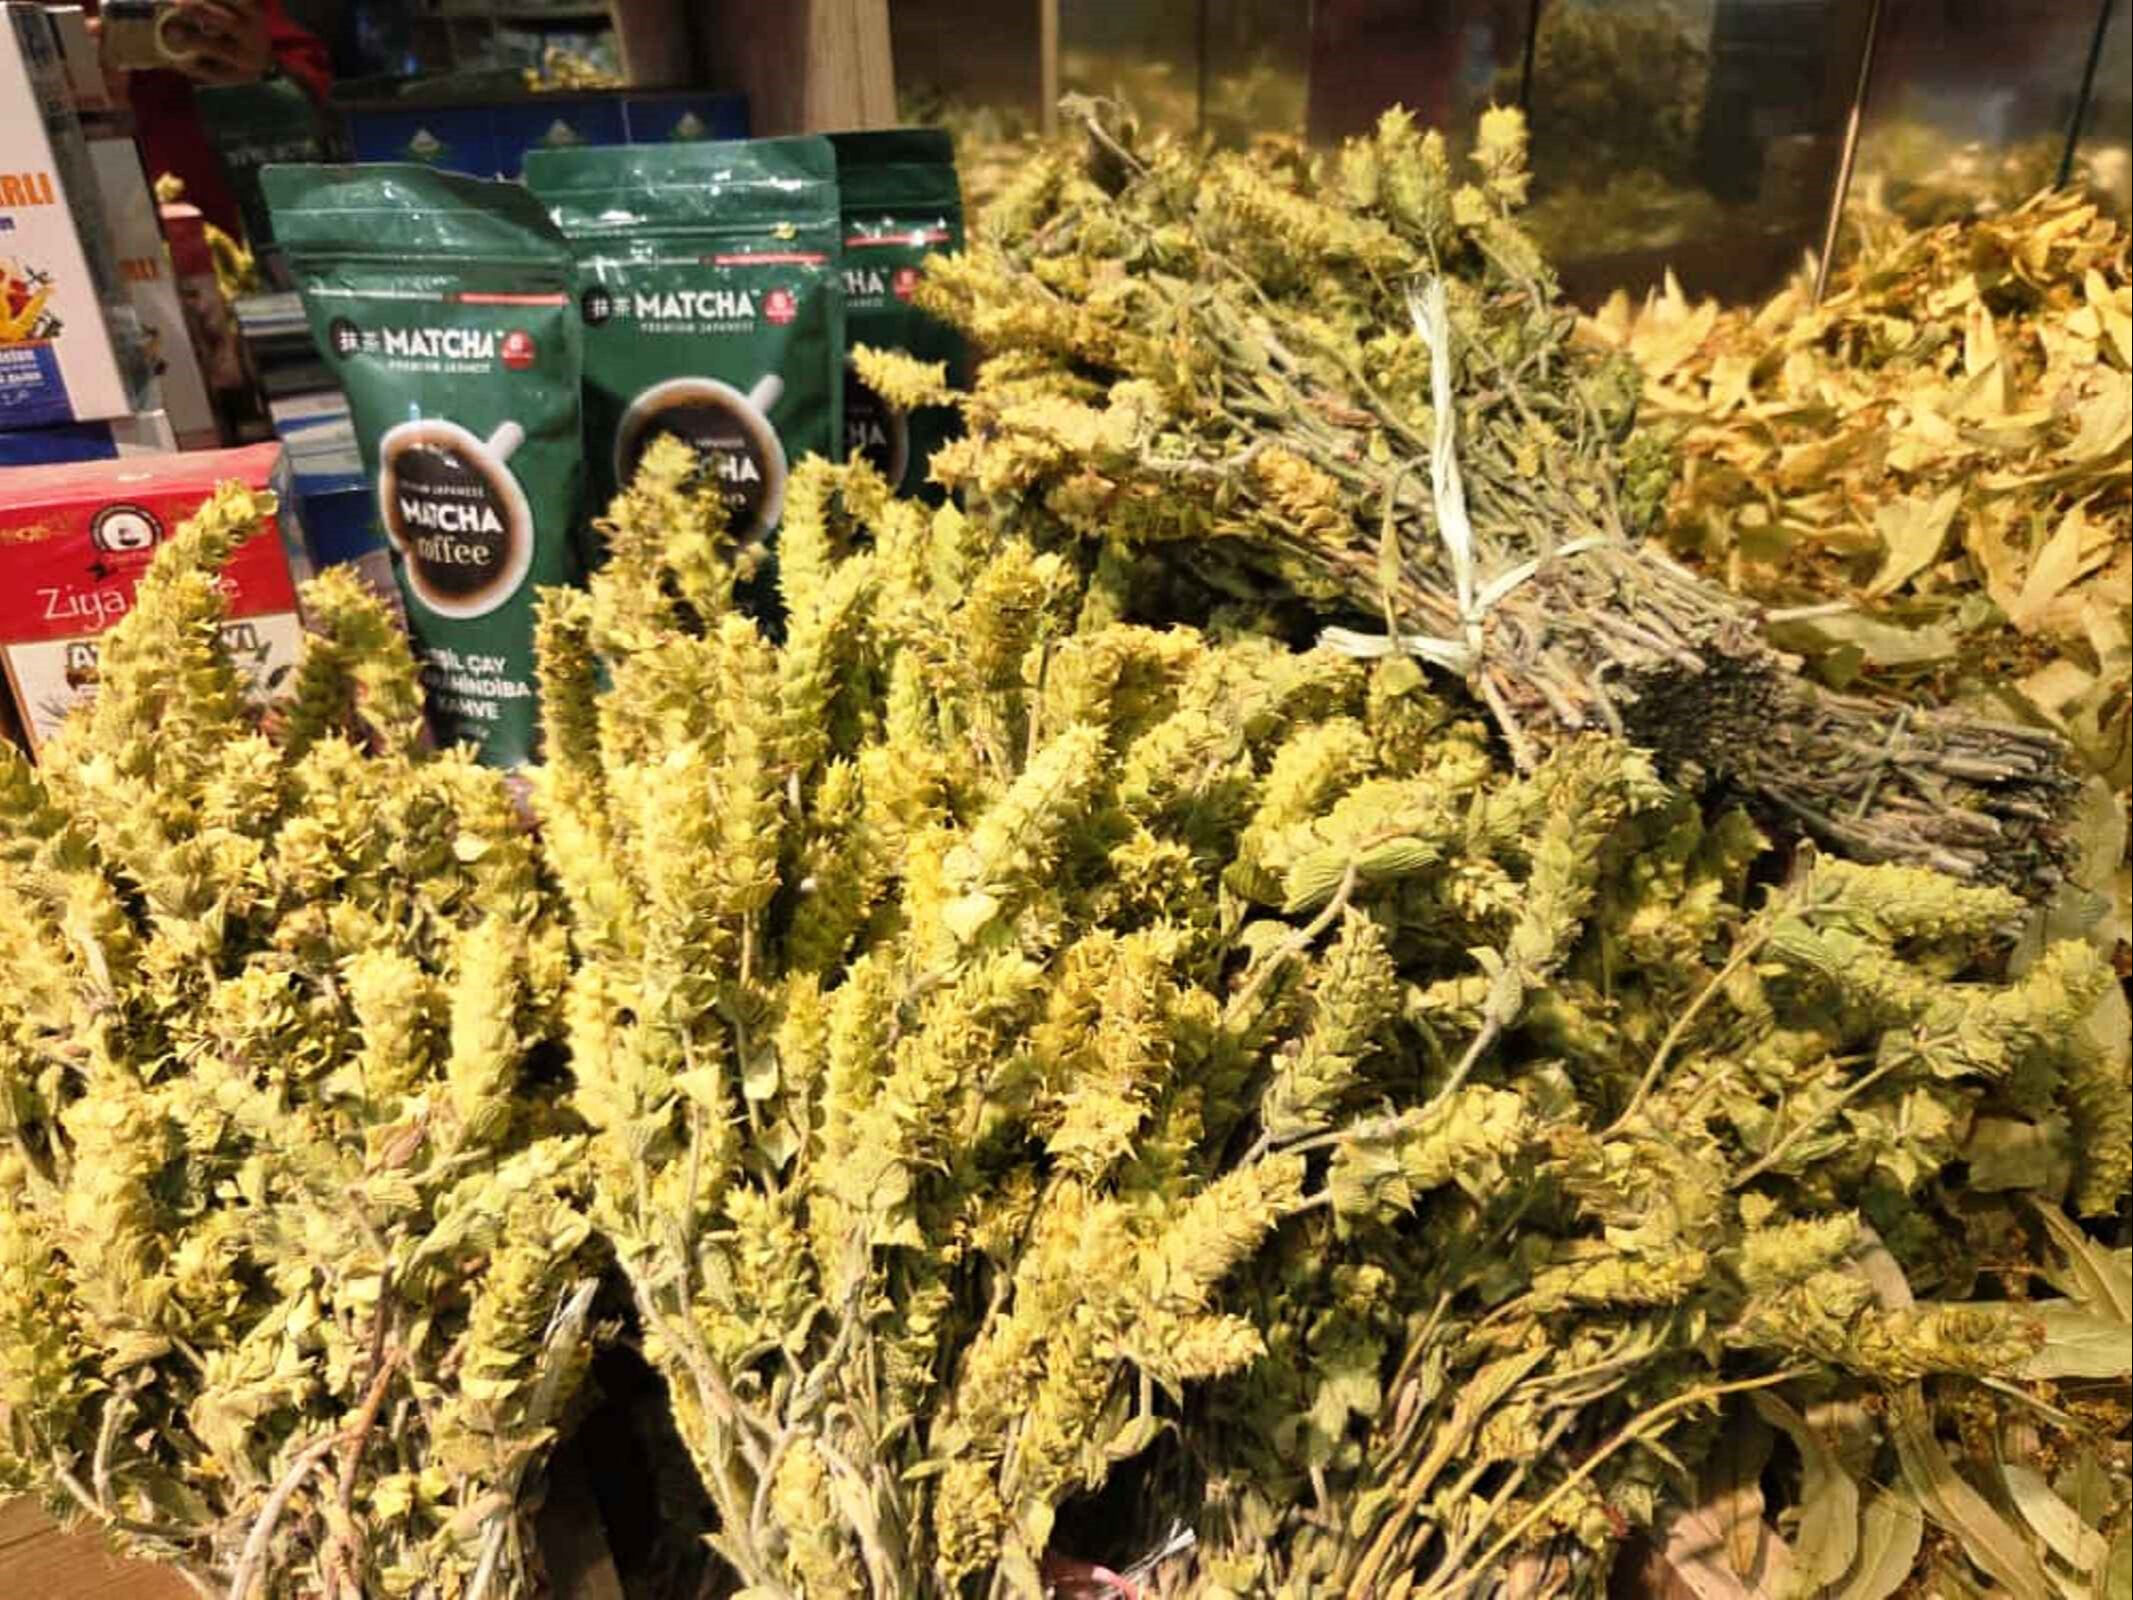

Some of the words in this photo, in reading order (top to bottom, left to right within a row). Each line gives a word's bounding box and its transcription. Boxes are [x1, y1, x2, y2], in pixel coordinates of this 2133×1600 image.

[0, 172, 55, 206] RLI
[633, 289, 755, 318] MATCHA
[382, 327, 495, 359] MATCHA
